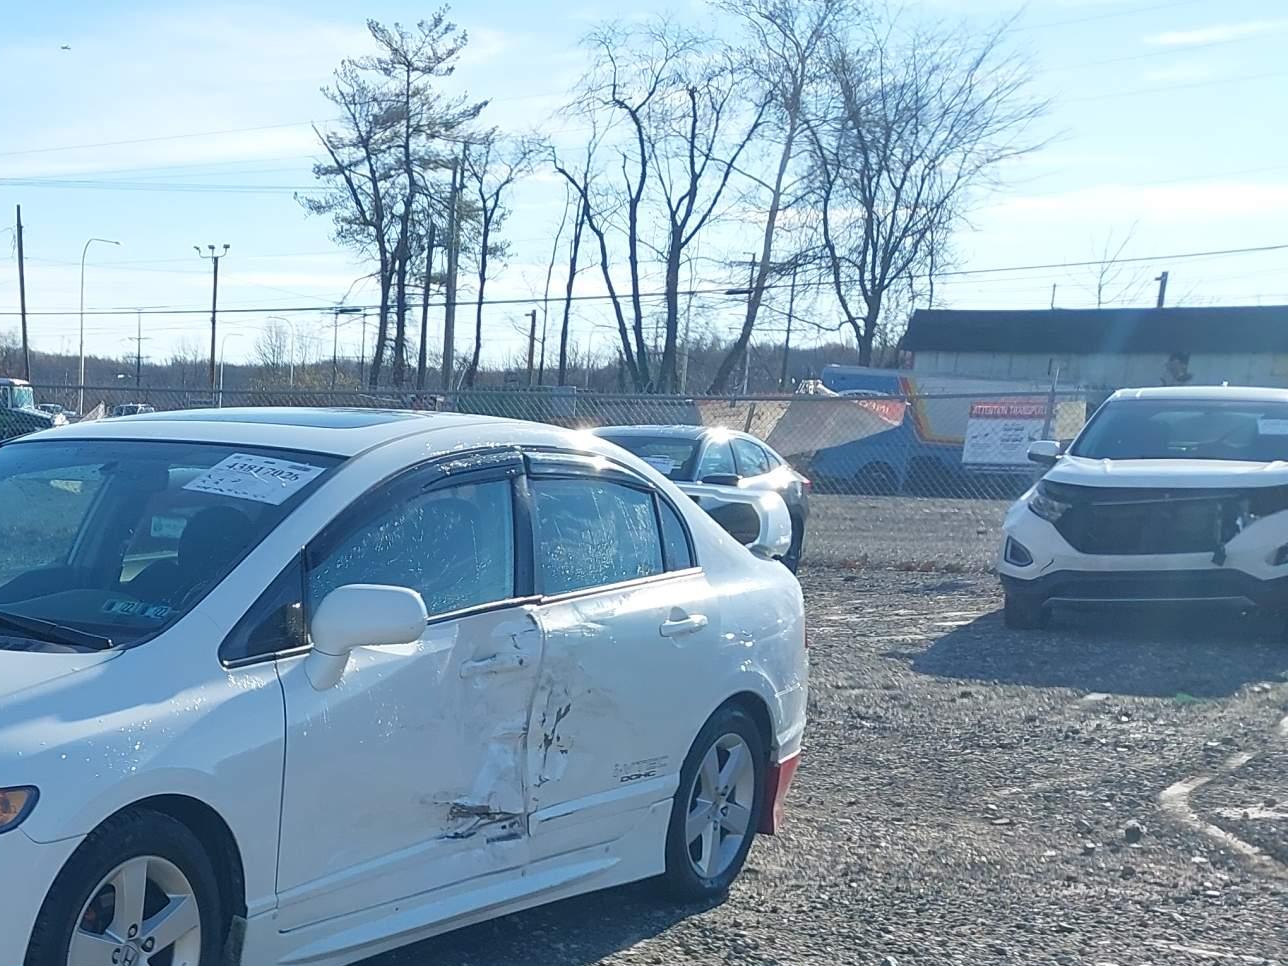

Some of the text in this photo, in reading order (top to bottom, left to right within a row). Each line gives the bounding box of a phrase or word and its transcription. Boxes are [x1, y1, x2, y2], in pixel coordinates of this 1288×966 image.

[972, 405, 1008, 416] ATTENTION
[226, 462, 300, 481] 43817026
[620, 770, 657, 782] DOHC
